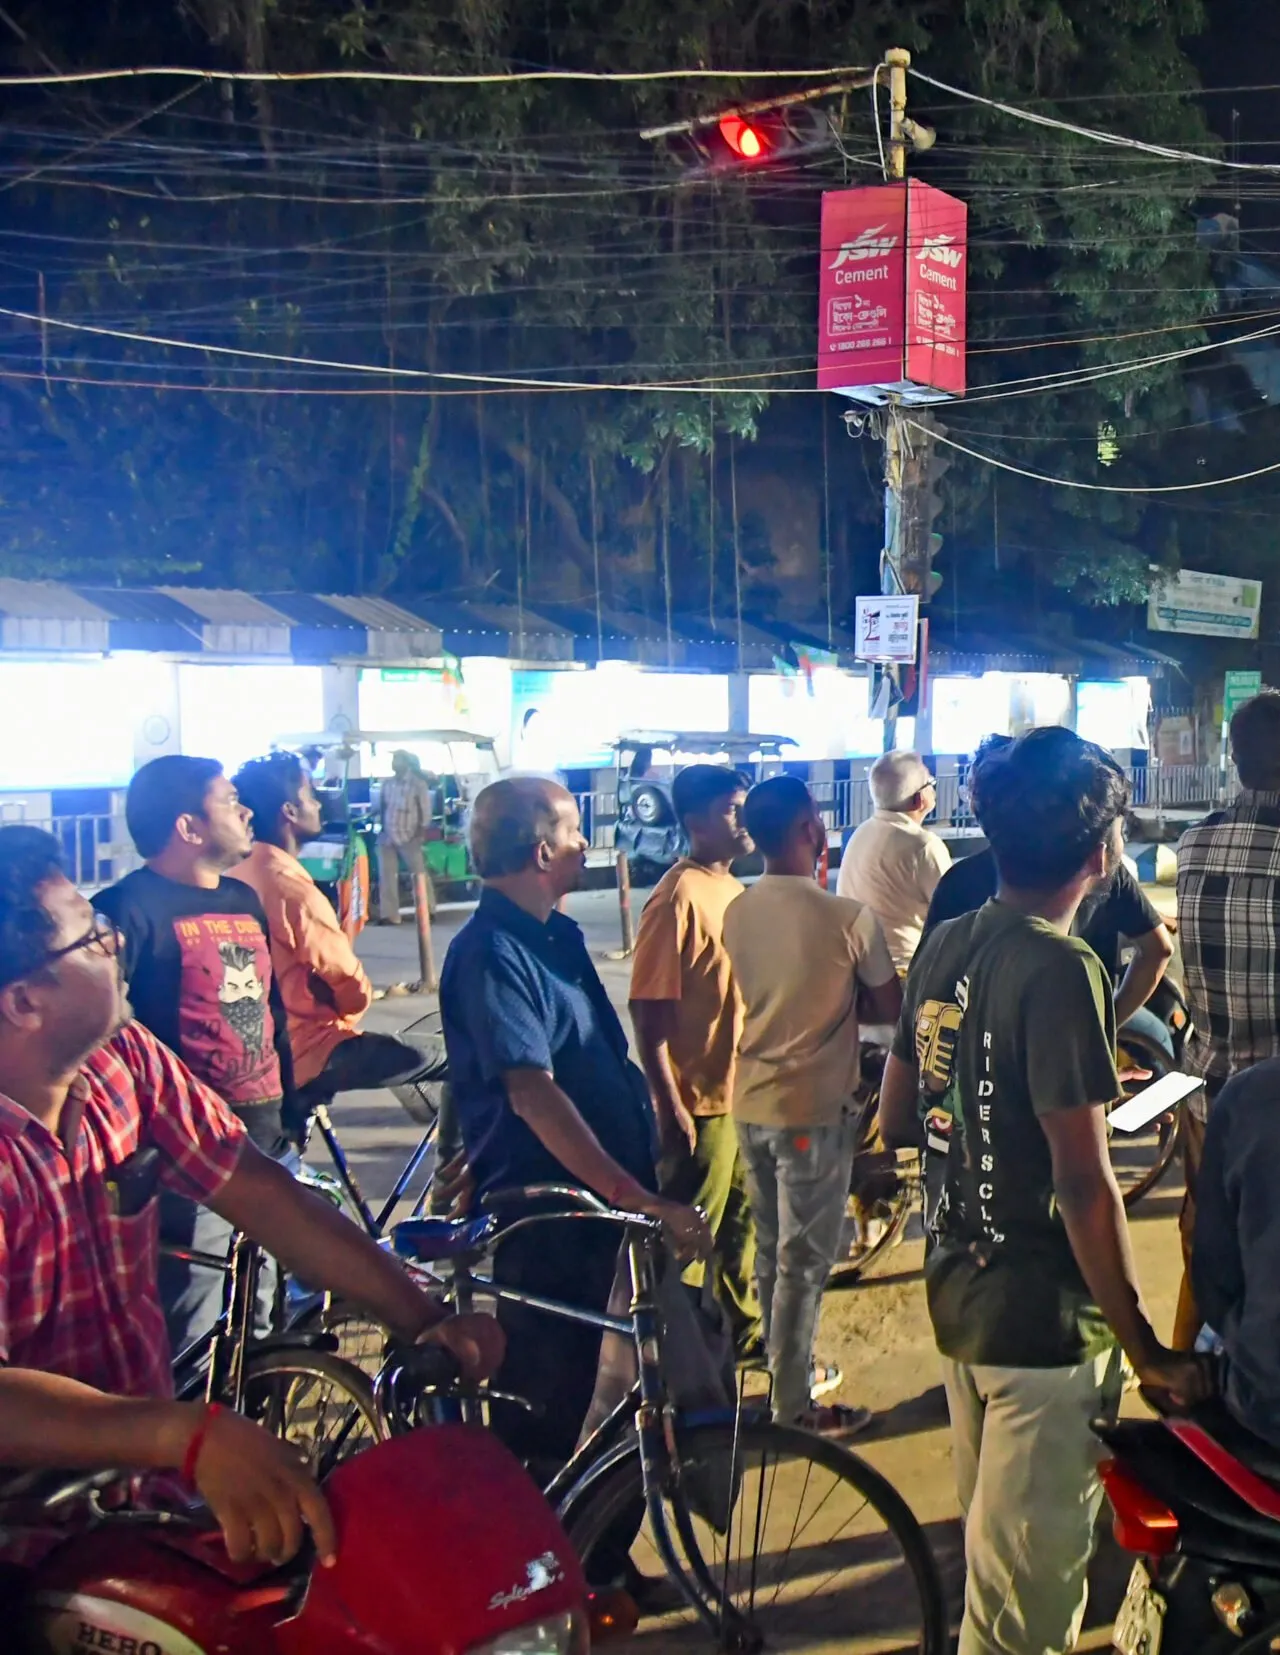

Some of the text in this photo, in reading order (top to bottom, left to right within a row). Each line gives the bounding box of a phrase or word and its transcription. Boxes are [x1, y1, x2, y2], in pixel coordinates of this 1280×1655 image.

[828, 227, 898, 270] JSW
[915, 233, 963, 268] JSW
[835, 266, 889, 284] Cement
[919, 264, 957, 291] Cement
[180, 920, 201, 937] IN
[203, 919, 233, 934] THE
[78, 1622, 162, 1655] HERO
